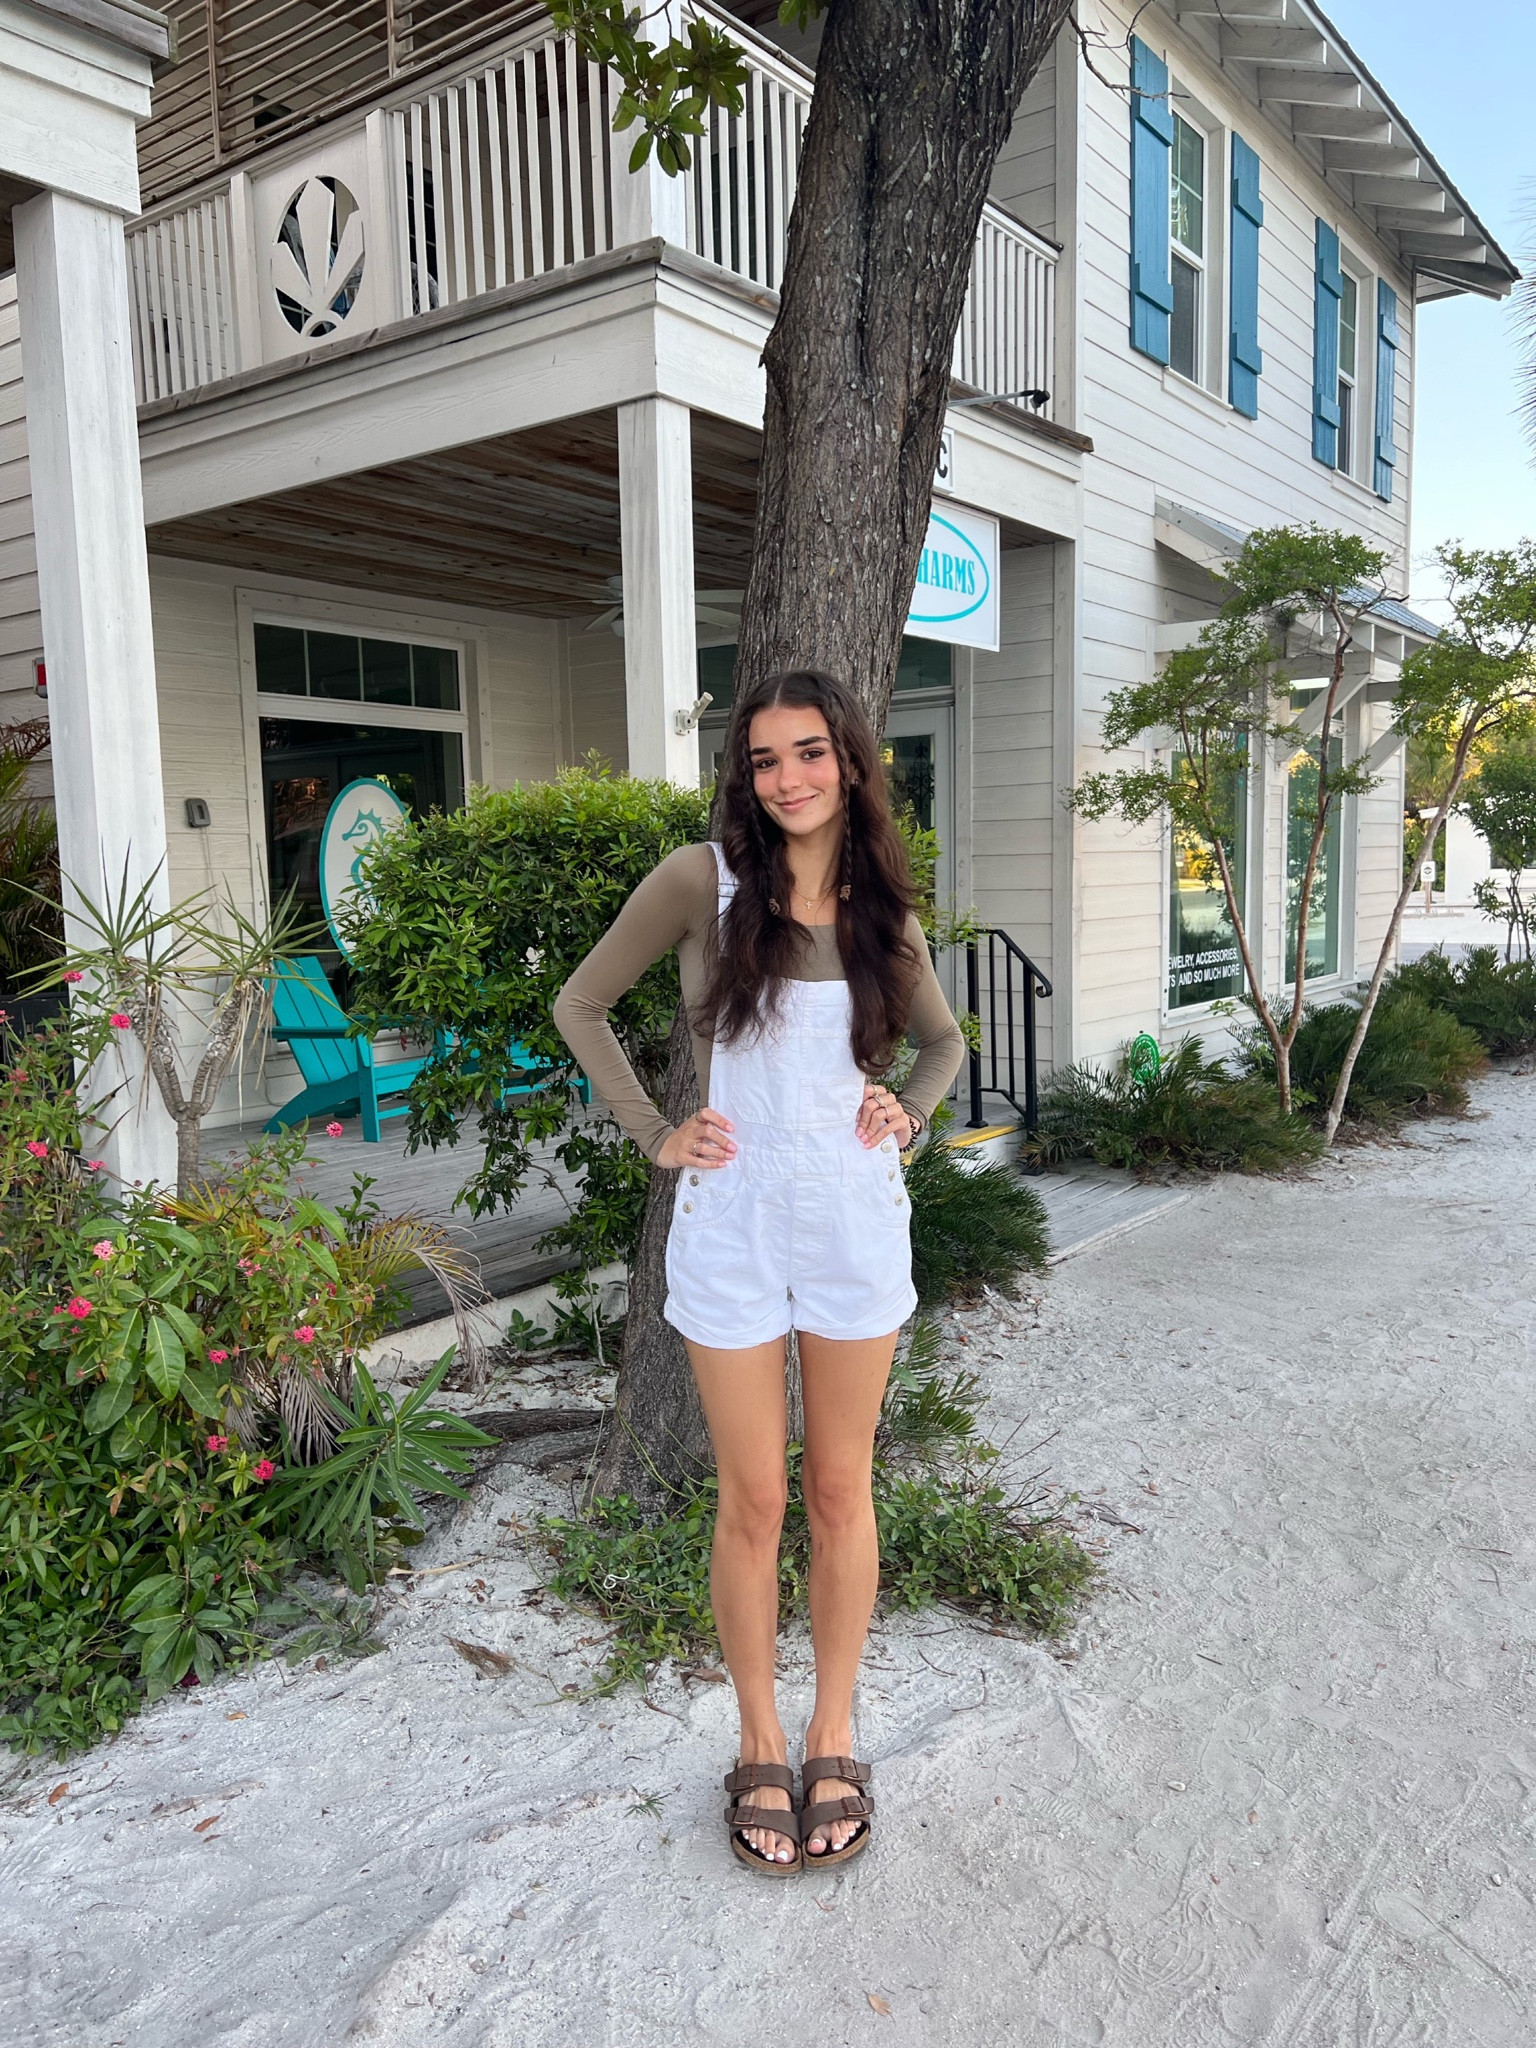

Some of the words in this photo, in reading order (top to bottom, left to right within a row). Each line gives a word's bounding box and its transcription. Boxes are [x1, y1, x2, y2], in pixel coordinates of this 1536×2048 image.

[1178, 971, 1193, 987] AND
[1194, 970, 1203, 983] SO
[1204, 967, 1221, 982] MUCH
[1223, 964, 1239, 978] MORE
